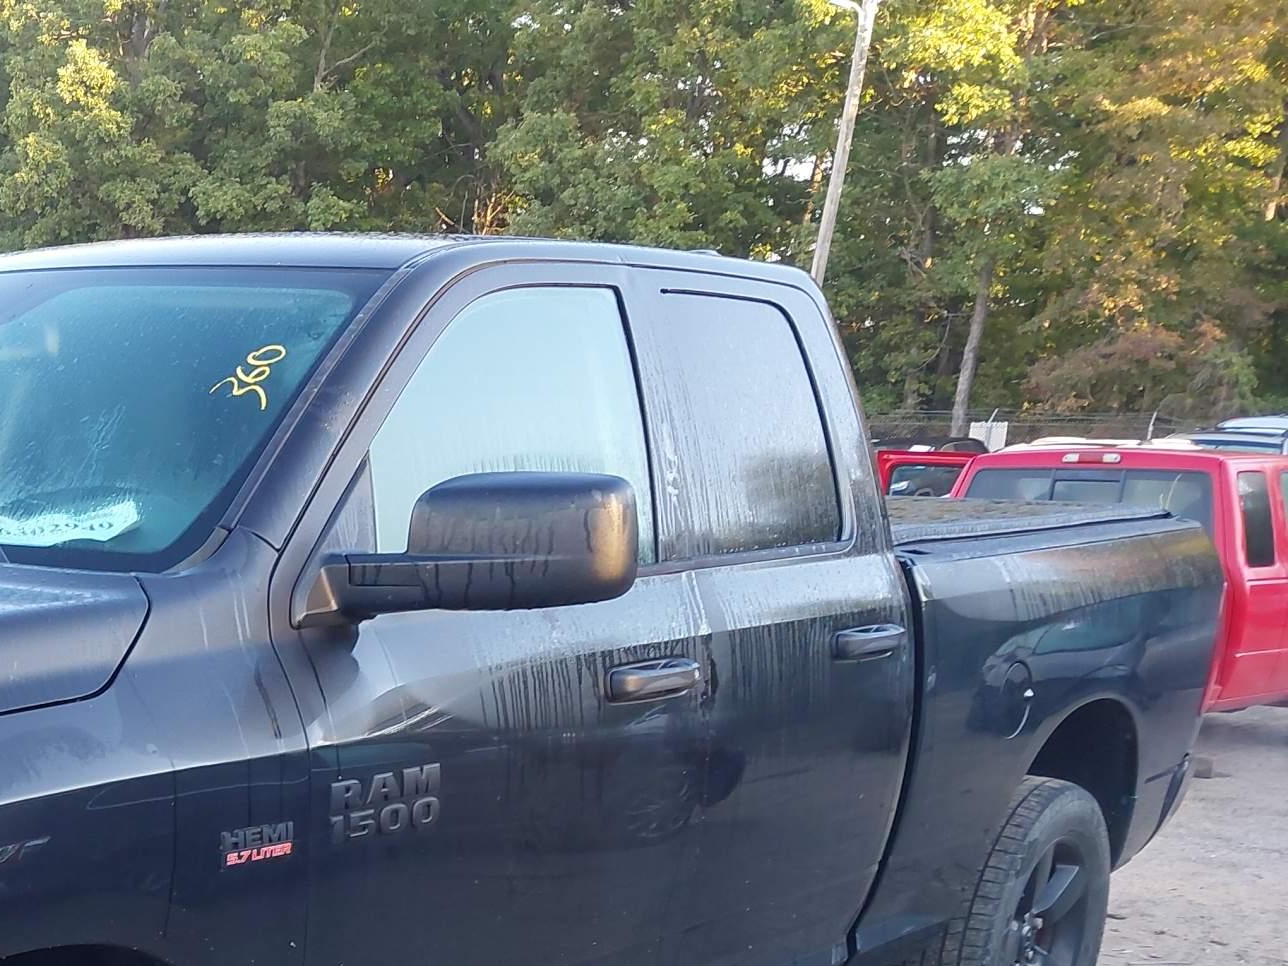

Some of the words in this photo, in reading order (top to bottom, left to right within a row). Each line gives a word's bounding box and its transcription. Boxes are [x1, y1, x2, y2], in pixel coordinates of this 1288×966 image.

[209, 344, 286, 410] 360
[328, 762, 441, 812] RAM
[220, 821, 294, 850] HEMI
[328, 796, 441, 845] 1500
[226, 850, 251, 866] 5.7
[251, 842, 292, 861] LITER
